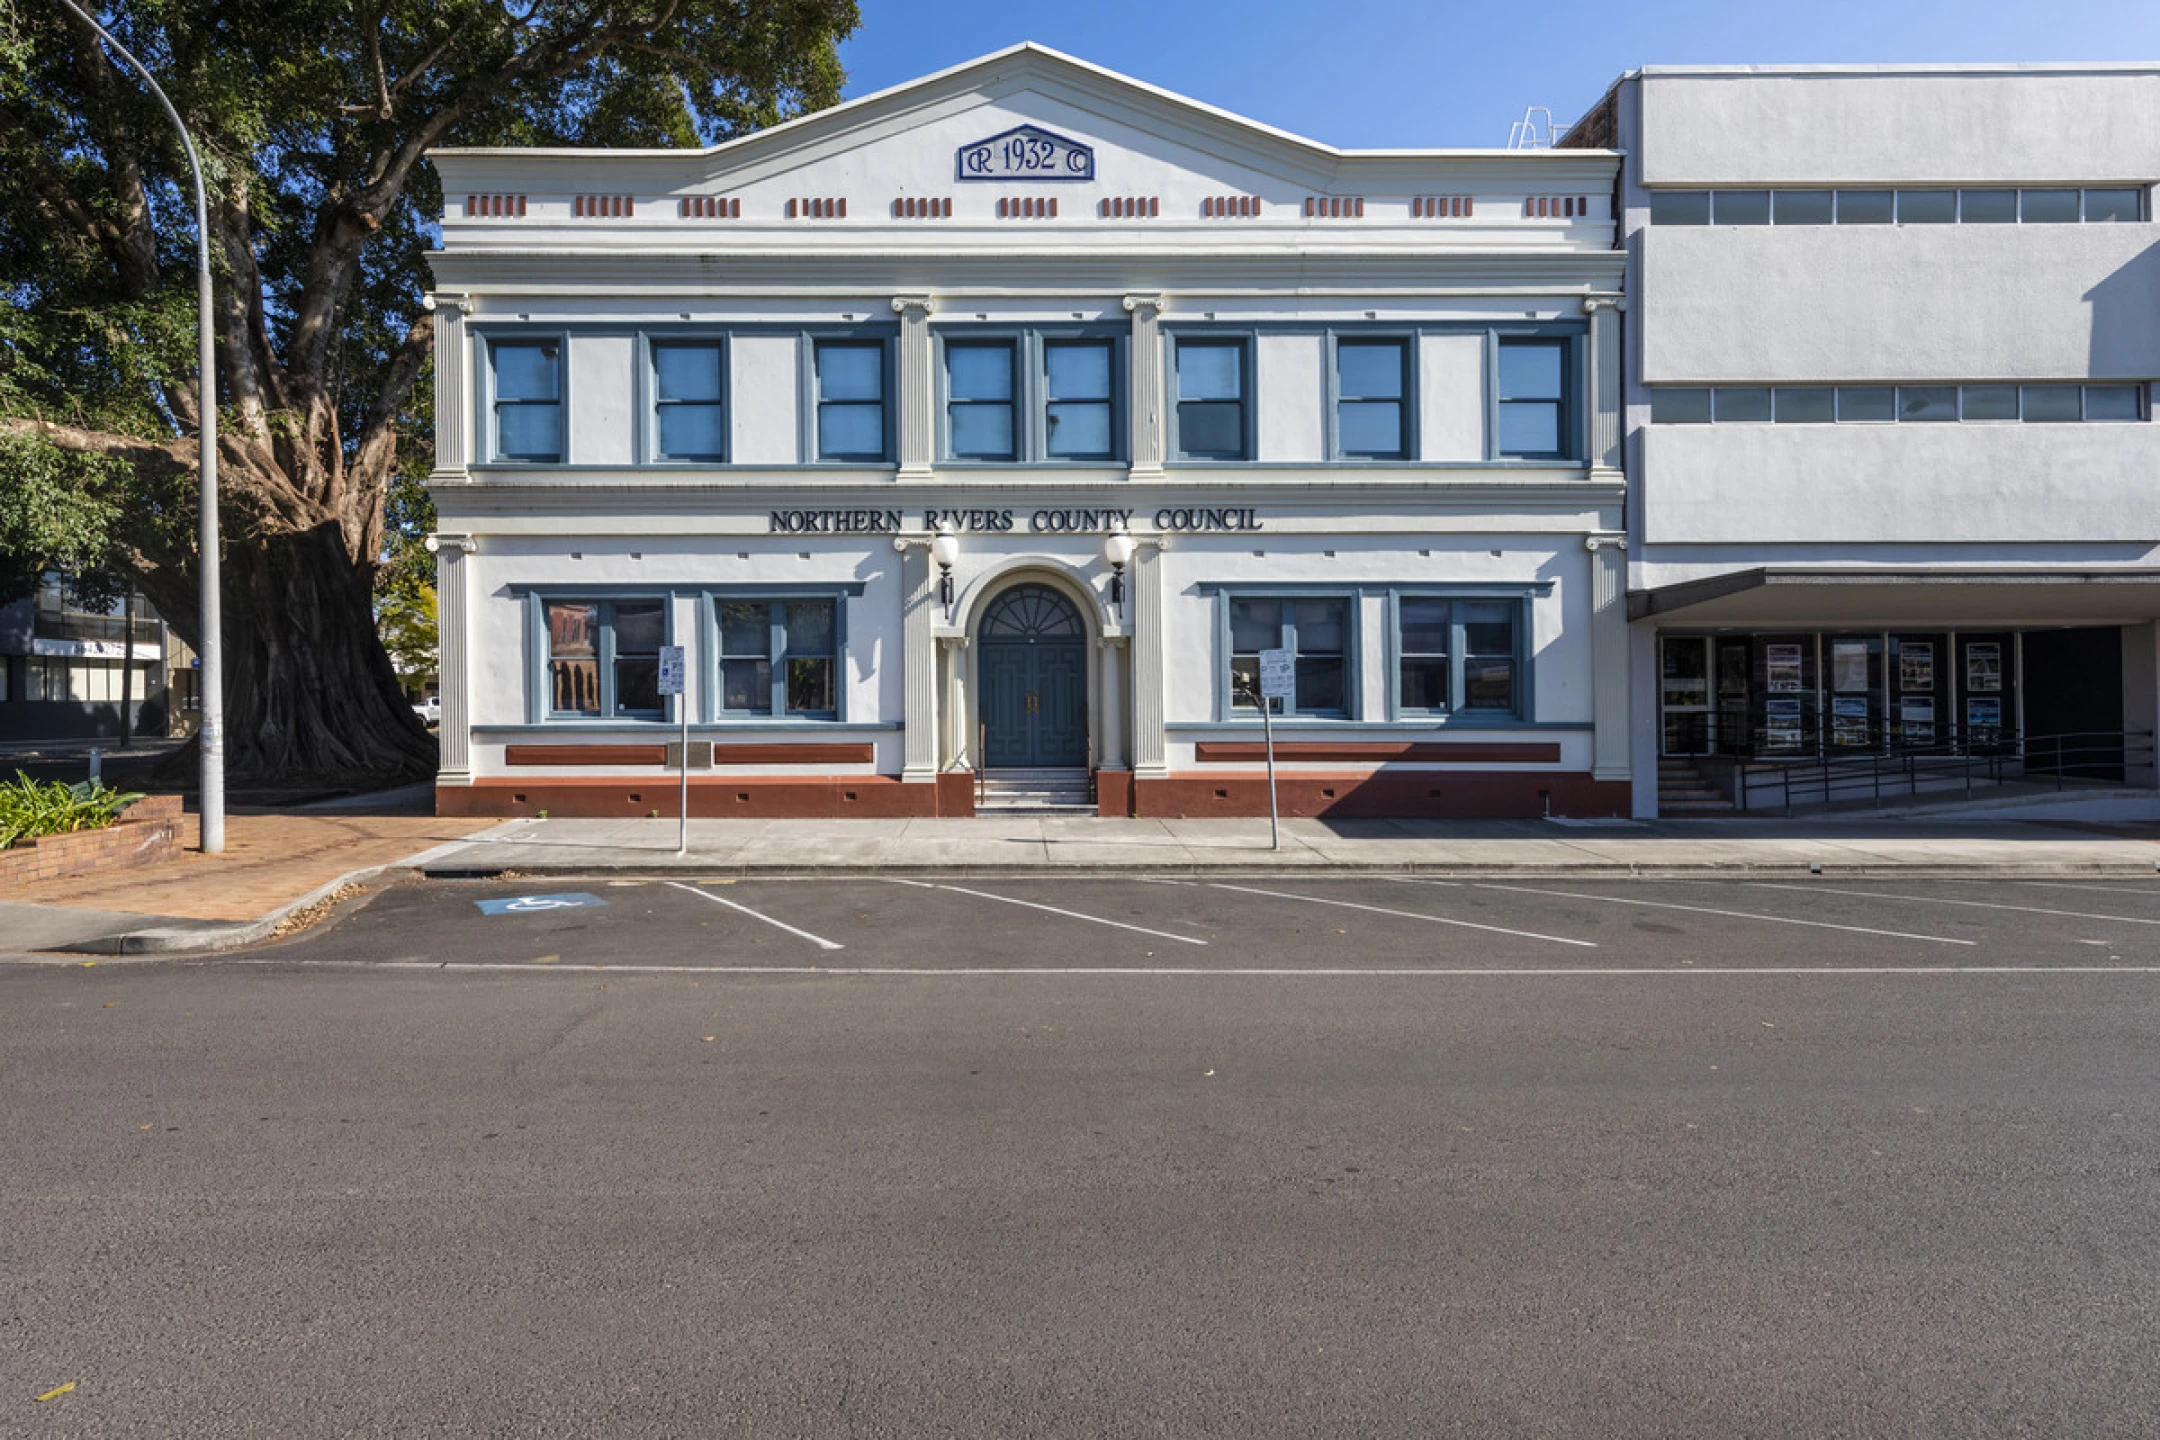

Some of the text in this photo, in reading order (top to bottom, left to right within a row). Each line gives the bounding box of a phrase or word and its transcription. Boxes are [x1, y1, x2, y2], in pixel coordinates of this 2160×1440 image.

[1003, 138, 1055, 171] 1932
[770, 510, 903, 532] NORTHERN
[1033, 508, 1134, 531] COUNTY
[1155, 508, 1263, 530] COUNCIL
